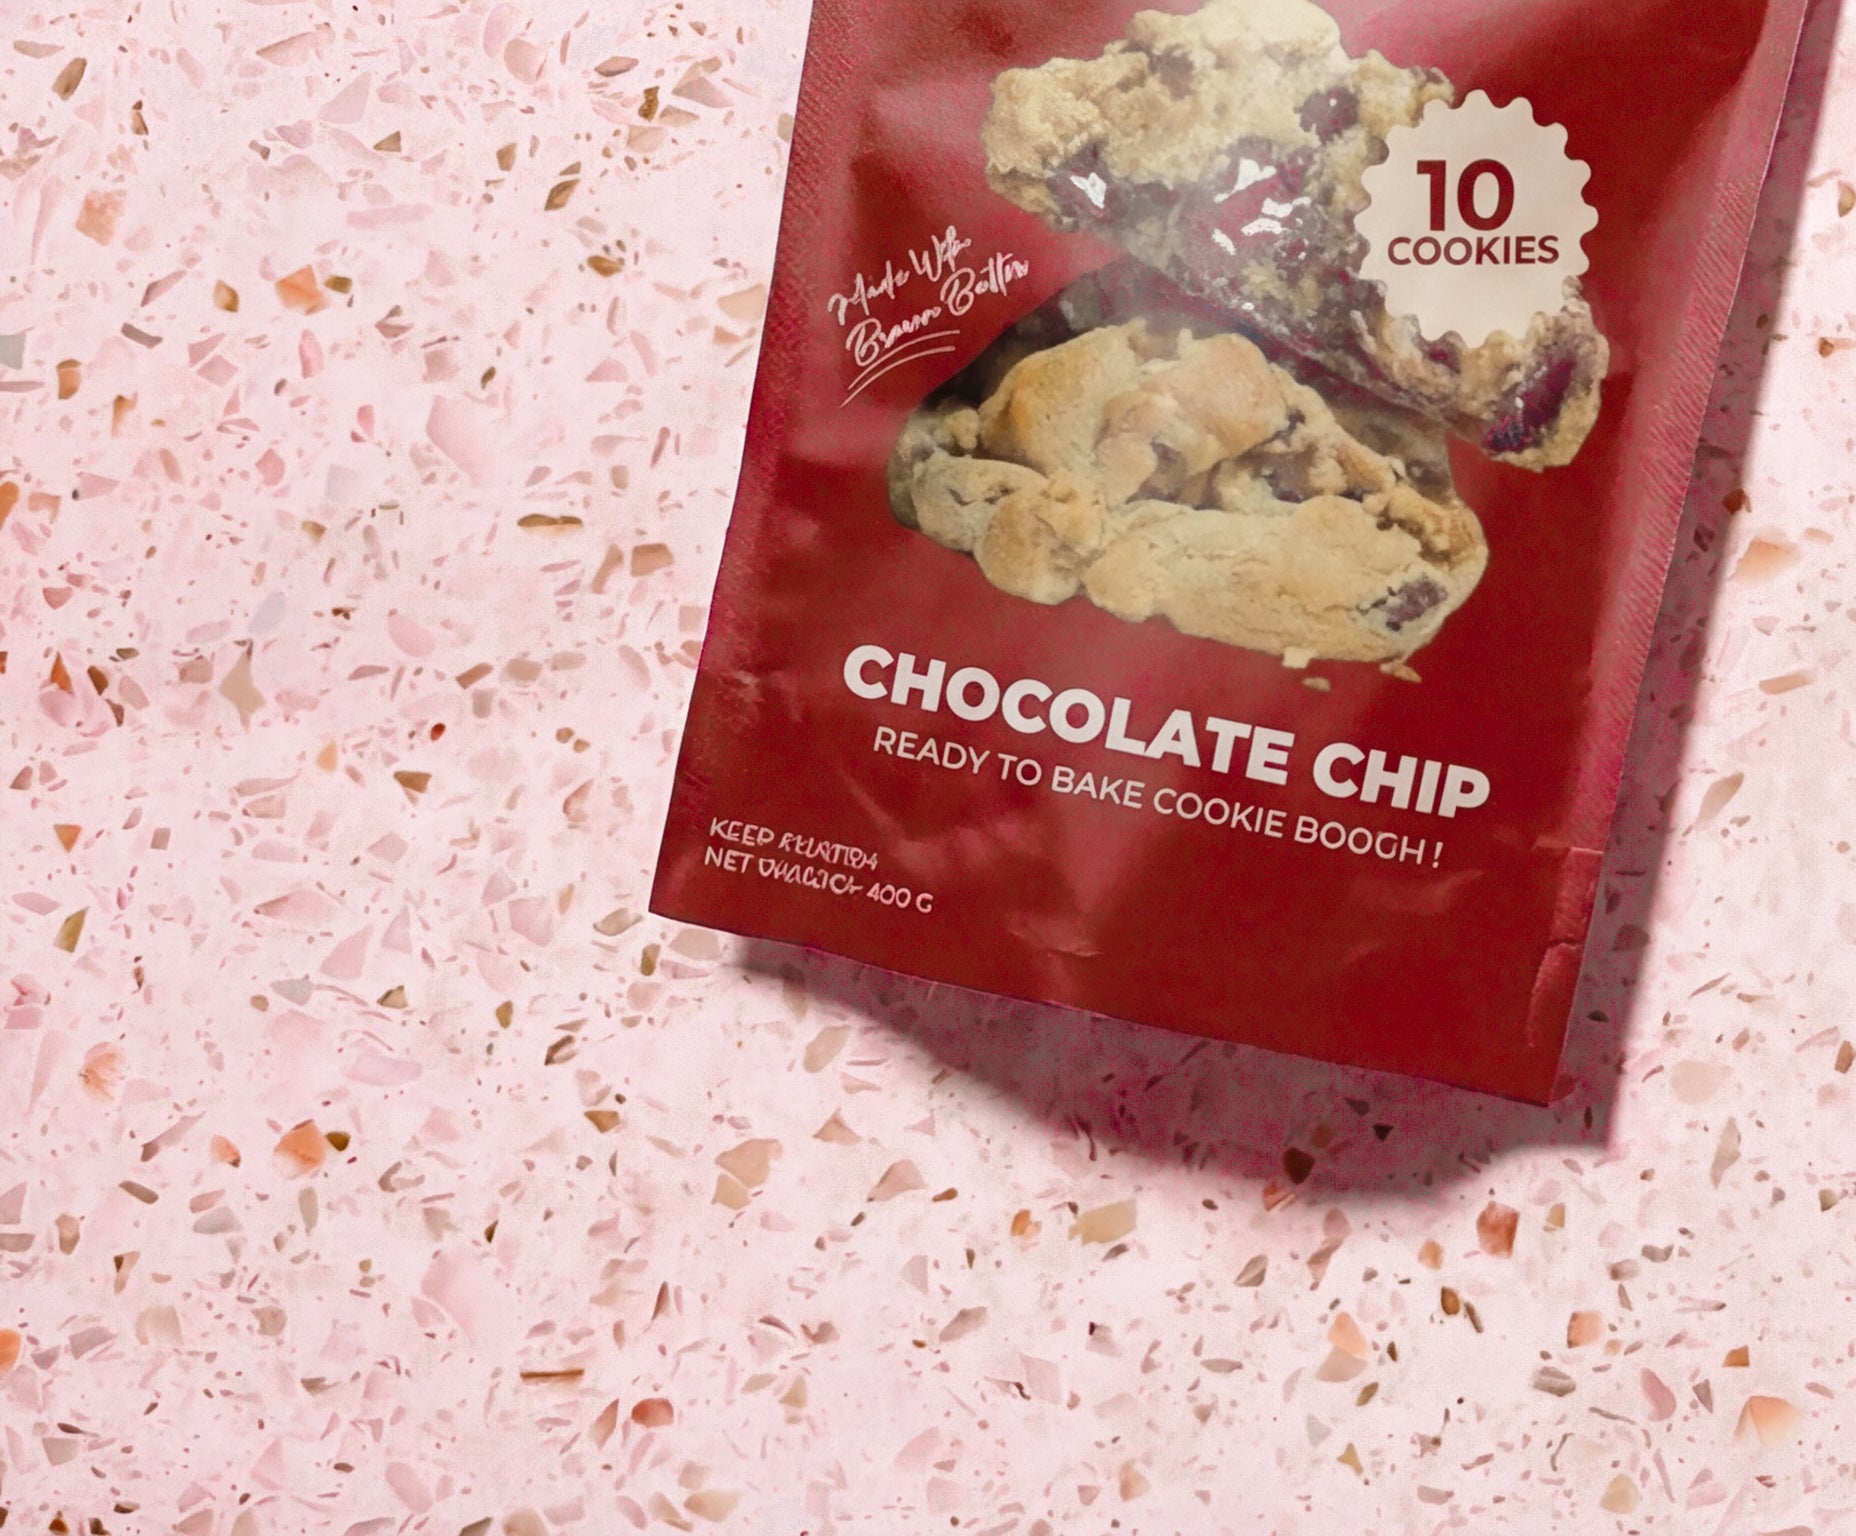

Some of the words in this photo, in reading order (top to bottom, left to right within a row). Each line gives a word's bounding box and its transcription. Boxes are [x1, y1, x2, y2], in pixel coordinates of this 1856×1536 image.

[1416, 158, 1515, 232] 10
[1387, 234, 1560, 266] COOKIES
[843, 644, 1295, 786] CHOCOLATE
[1312, 742, 1491, 818] CHIP
[873, 725, 992, 775] READY
[998, 752, 1043, 786] TO
[1051, 766, 1146, 810] BAKE
[1153, 787, 1288, 838] COOKIE
[709, 817, 776, 847] KEEP
[704, 845, 754, 874] NET
[866, 882, 912, 909] 400
[916, 892, 935, 914] G
